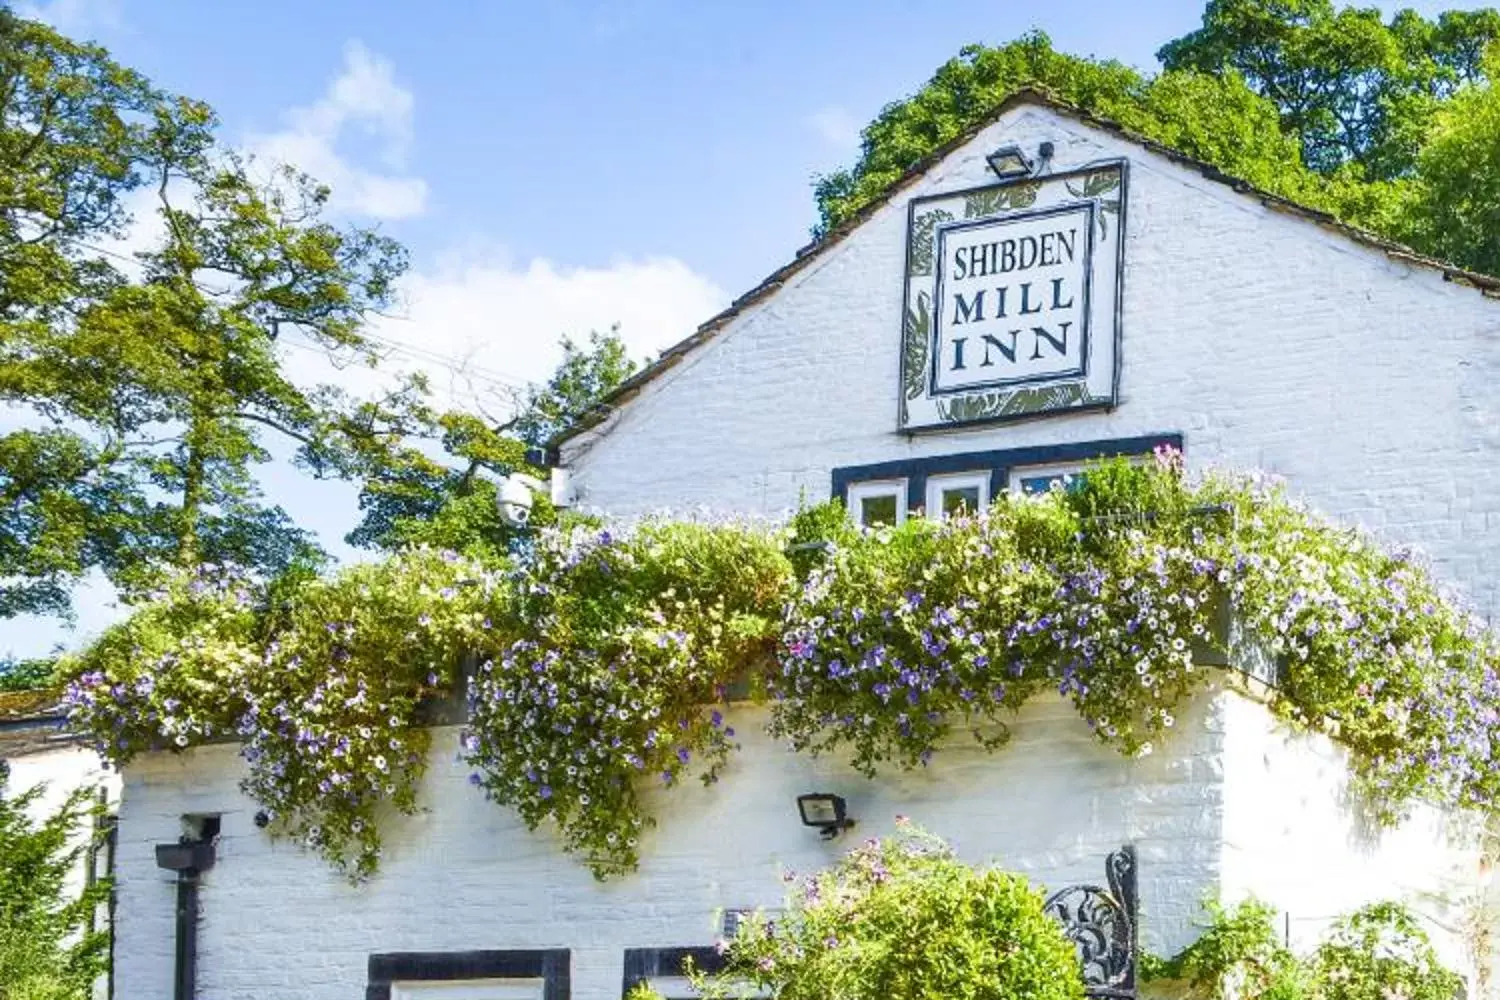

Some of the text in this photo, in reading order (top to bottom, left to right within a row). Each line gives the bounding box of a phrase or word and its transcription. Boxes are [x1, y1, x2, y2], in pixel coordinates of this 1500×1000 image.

[953, 229, 1077, 281] SHIBDEN
[951, 277, 1075, 325] MILL
[950, 321, 1073, 371] INN
